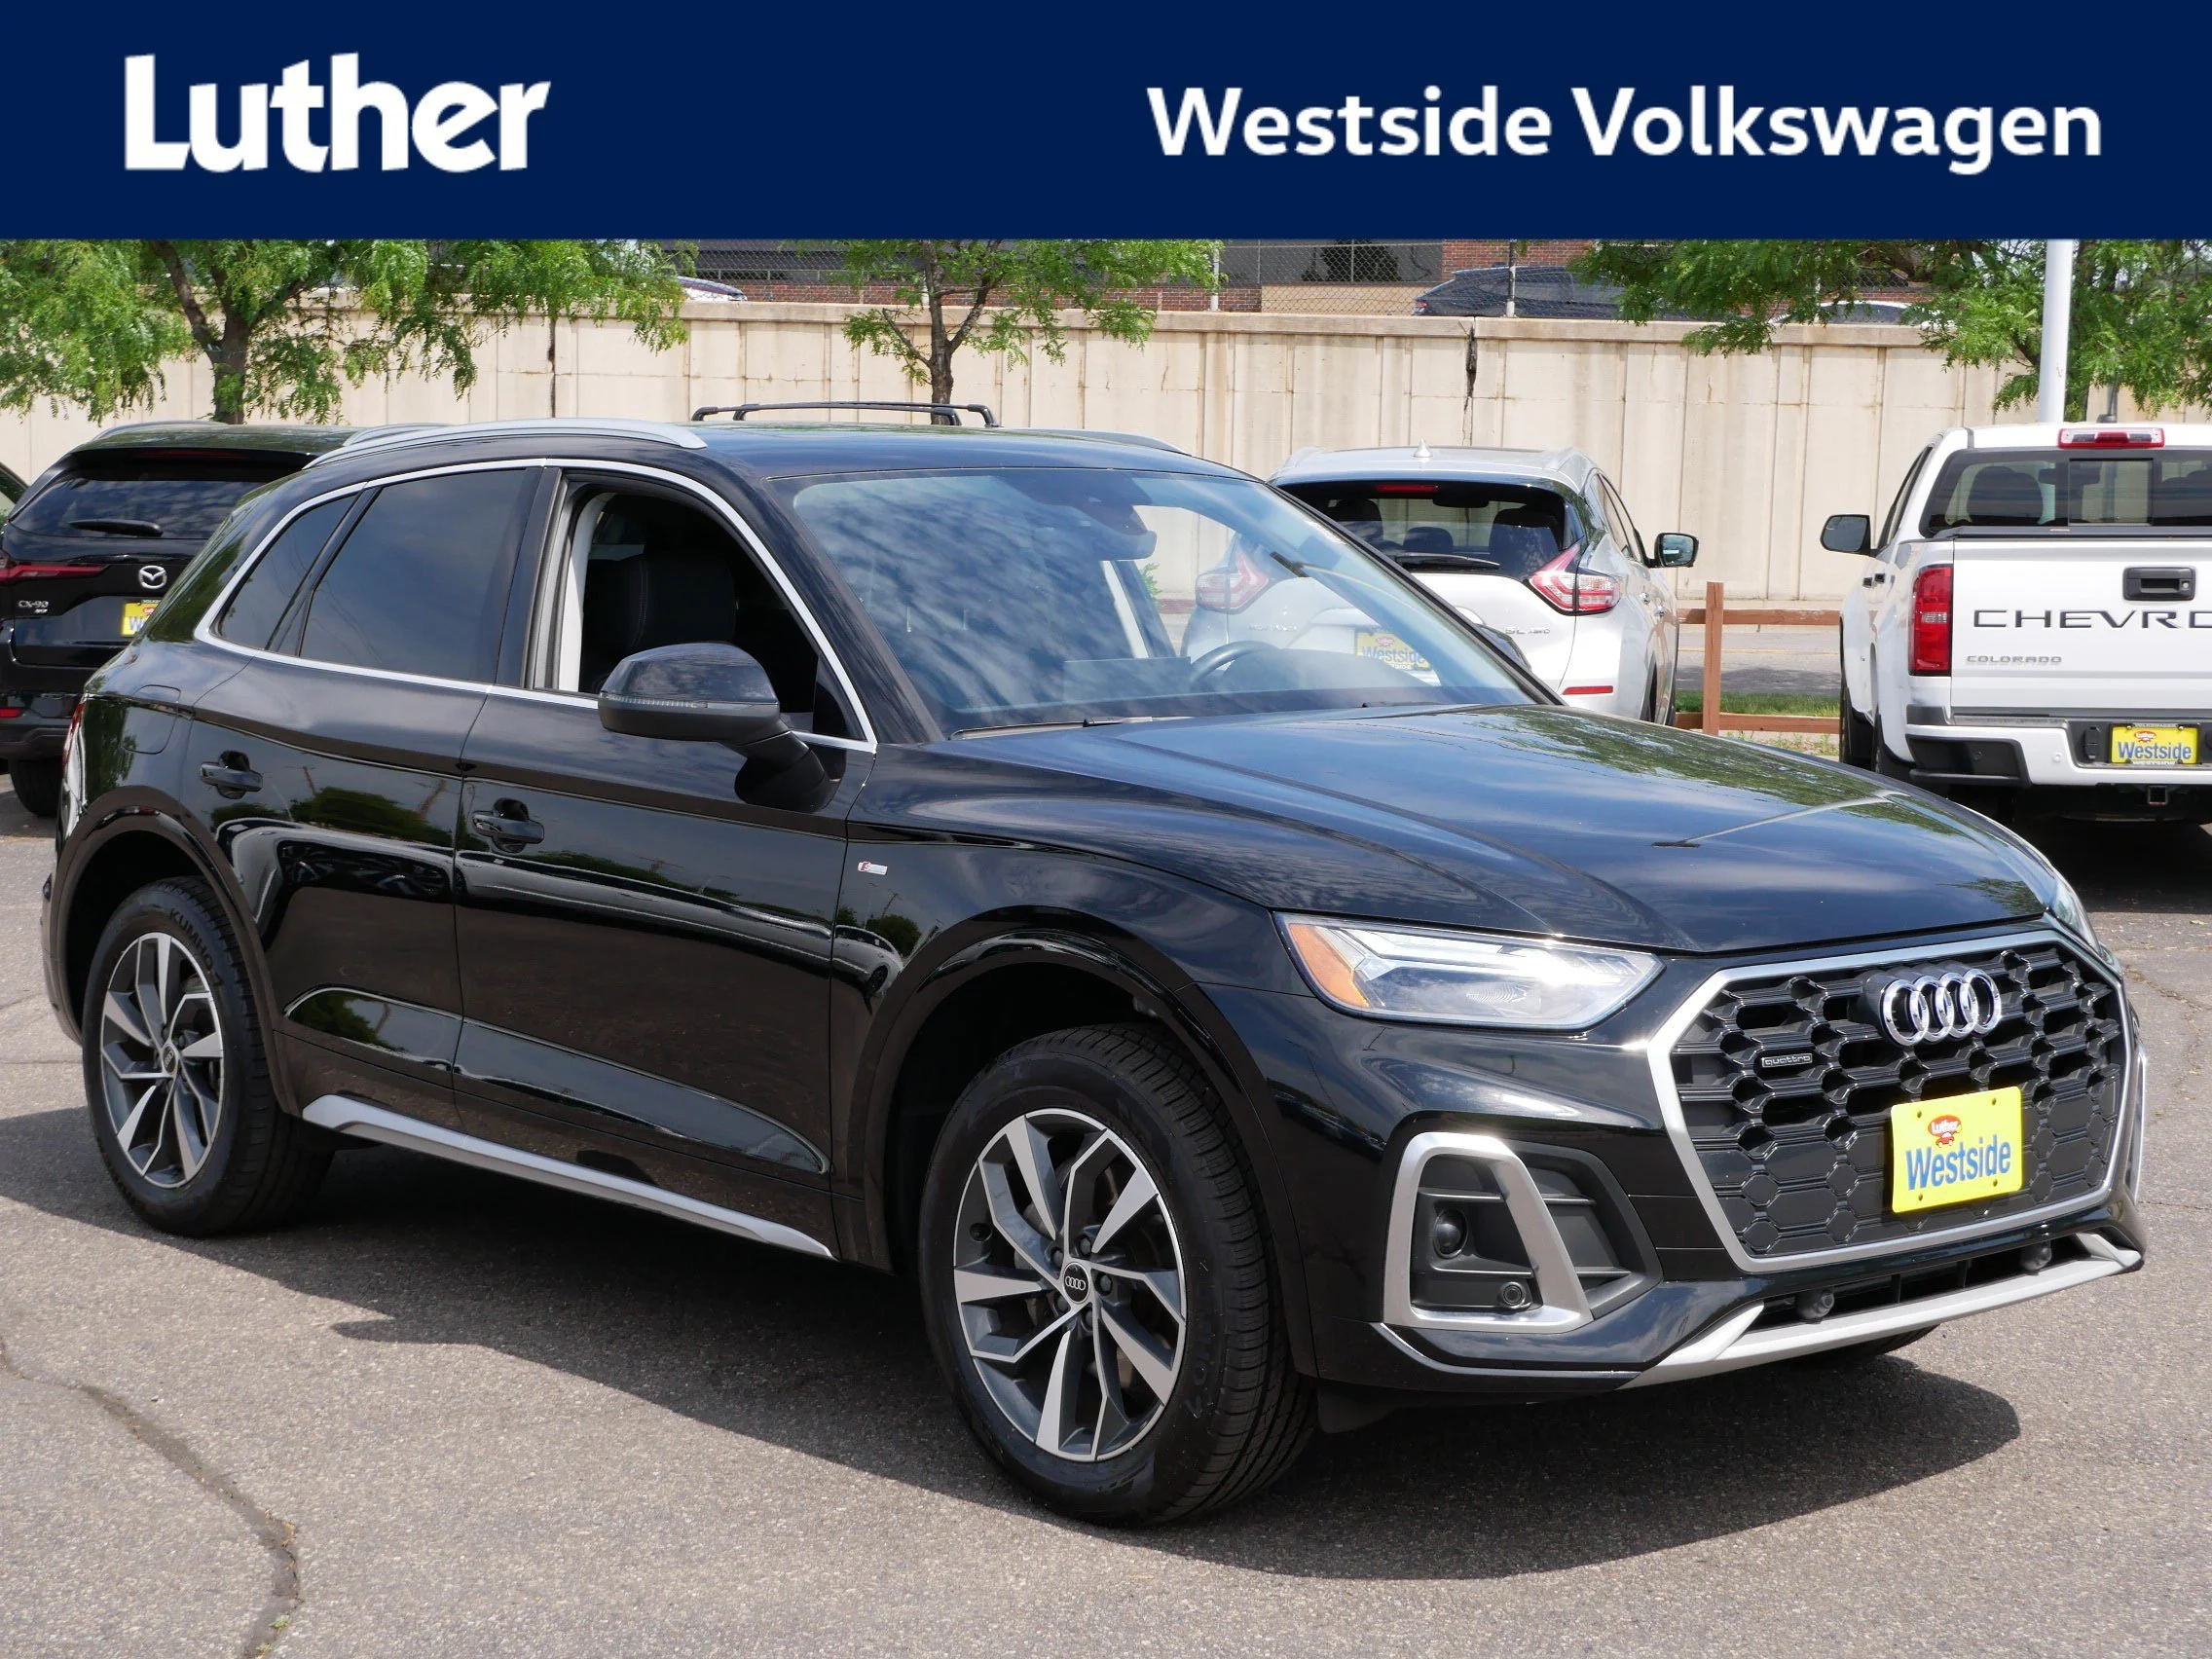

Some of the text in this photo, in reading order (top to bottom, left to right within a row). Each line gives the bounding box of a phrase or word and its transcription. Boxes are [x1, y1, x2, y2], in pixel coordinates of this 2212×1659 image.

[1967, 655, 2062, 664] COLORADO
[2117, 741, 2193, 759] Westside
[1764, 1054, 1812, 1066] quattro
[1905, 1134, 2011, 1191] Westside
